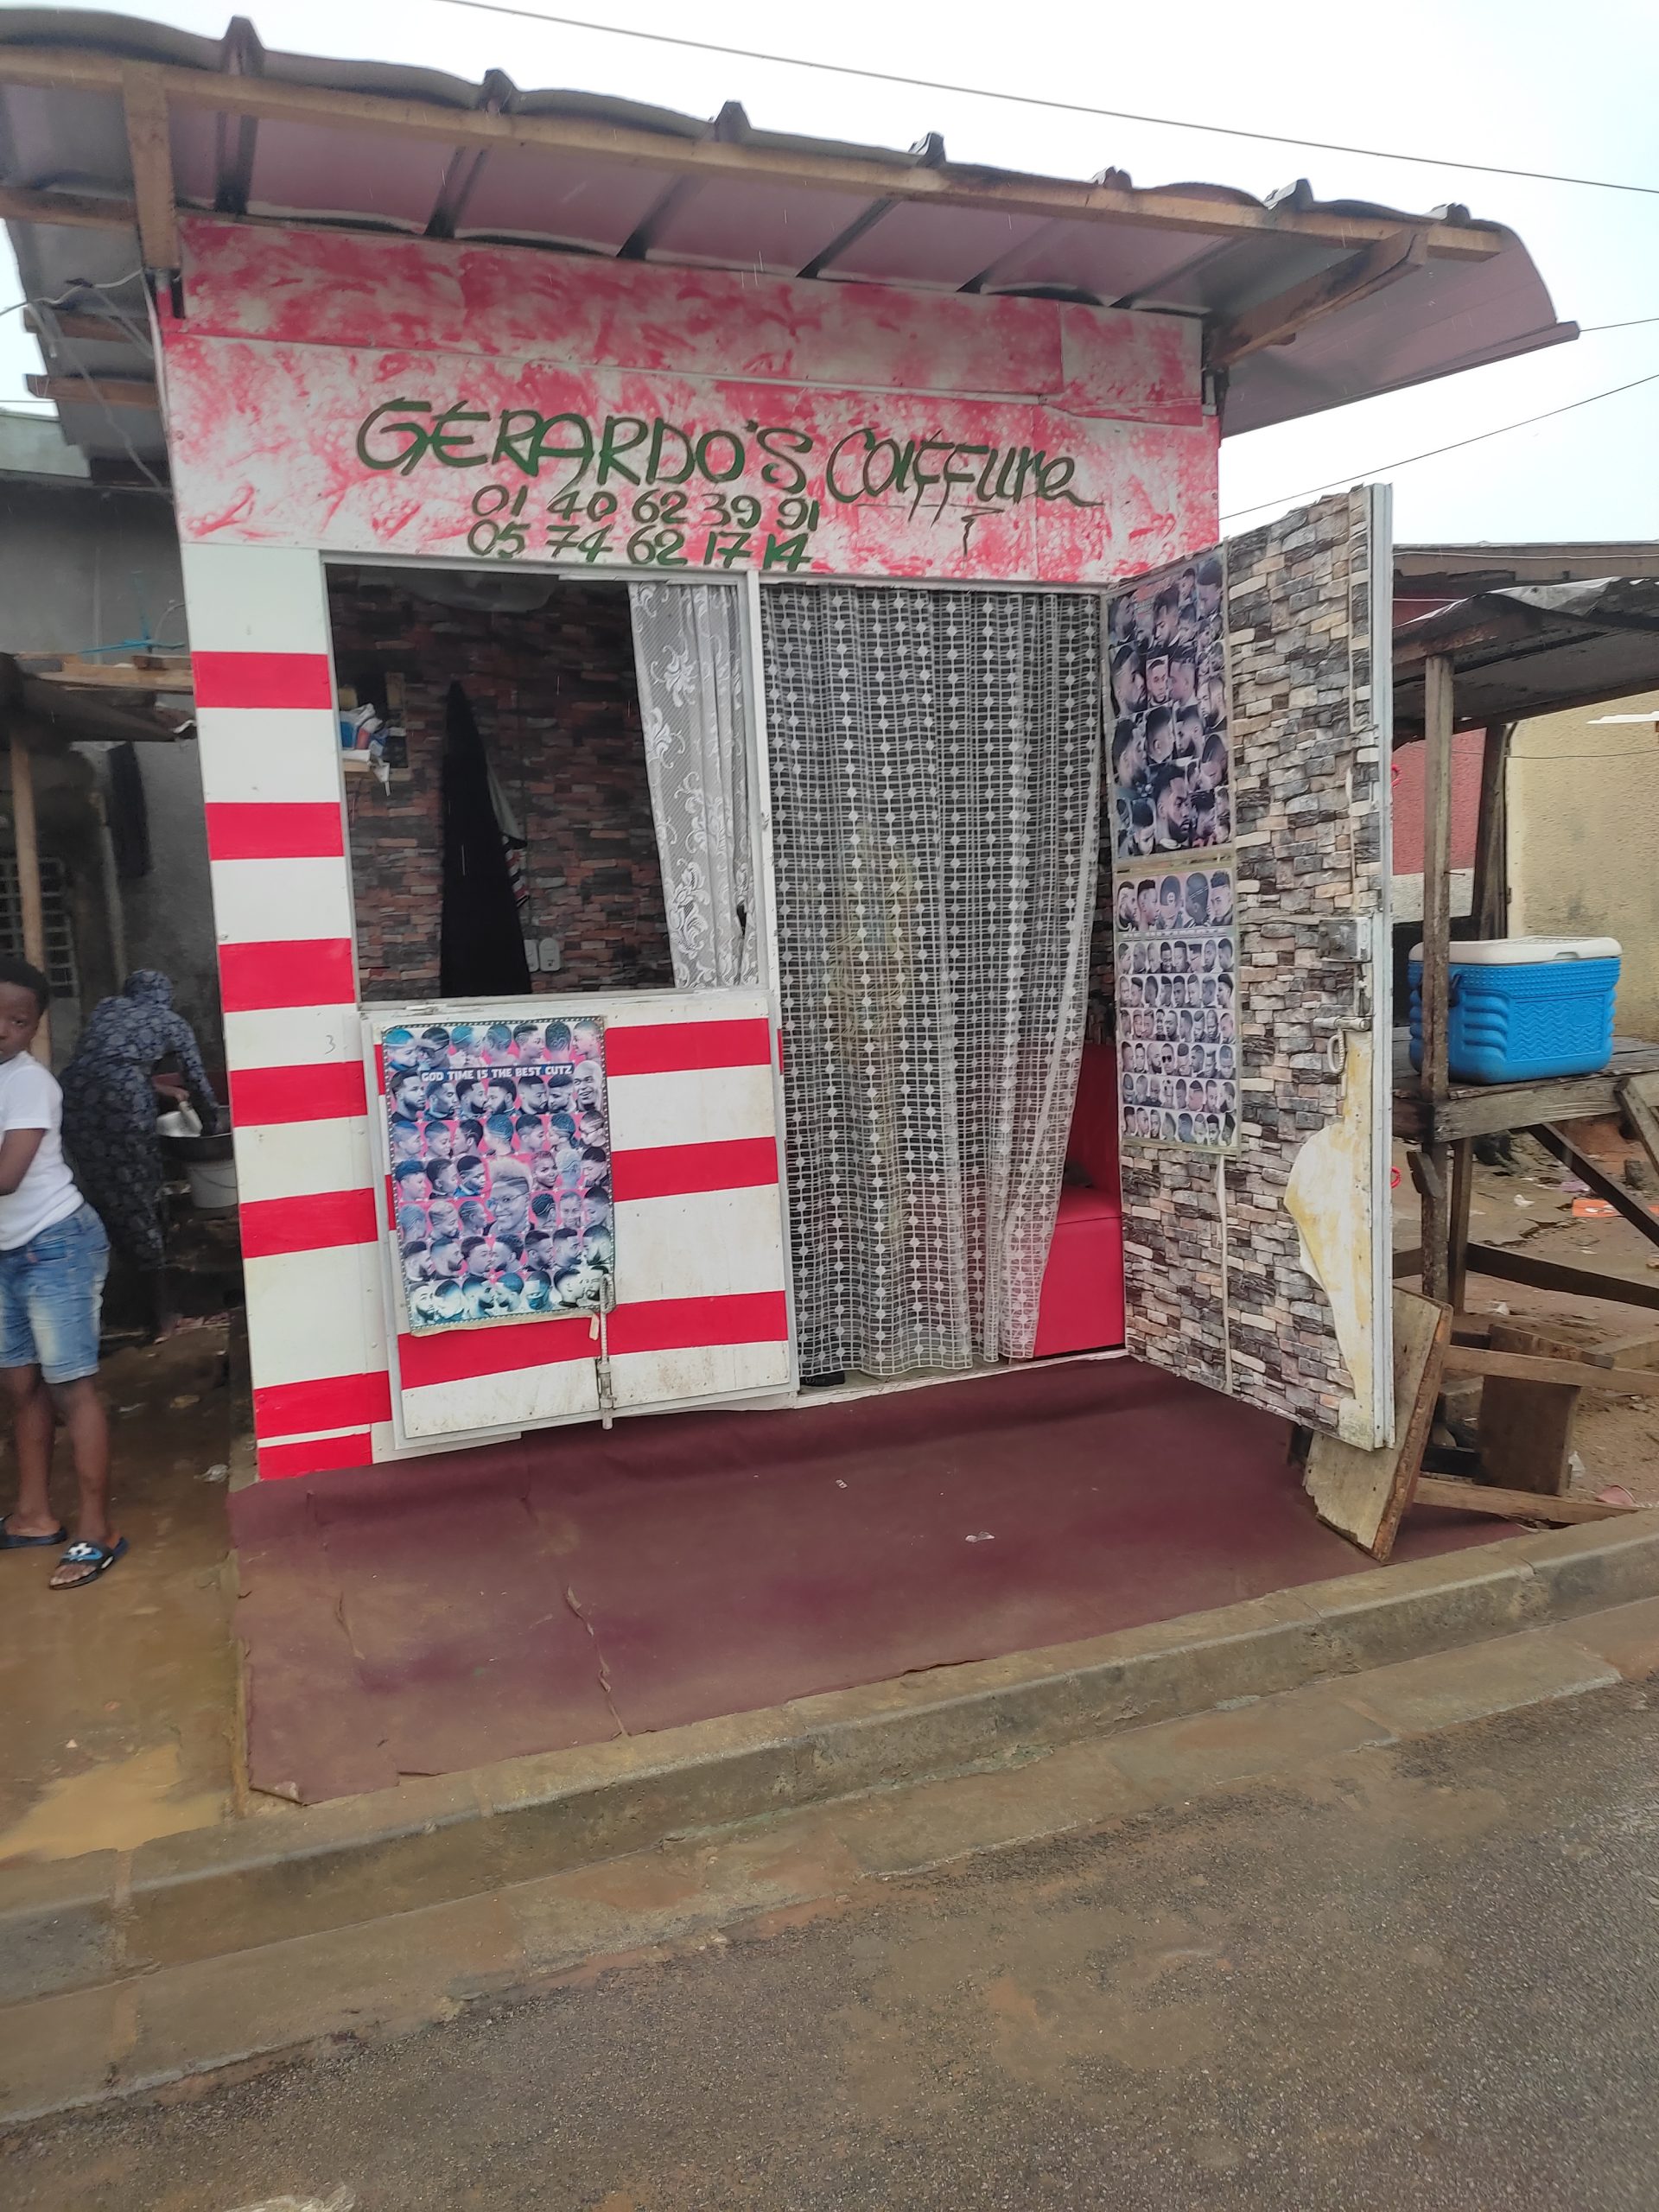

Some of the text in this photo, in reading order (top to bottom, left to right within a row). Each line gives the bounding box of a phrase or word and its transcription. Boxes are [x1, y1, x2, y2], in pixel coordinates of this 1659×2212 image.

[472, 484, 820, 532] 01 40 62 39 91
[467, 518, 814, 572] 05 74 62 17 14
[421, 1065, 573, 1081] GOD TIME IS THE BEST CUTZ
